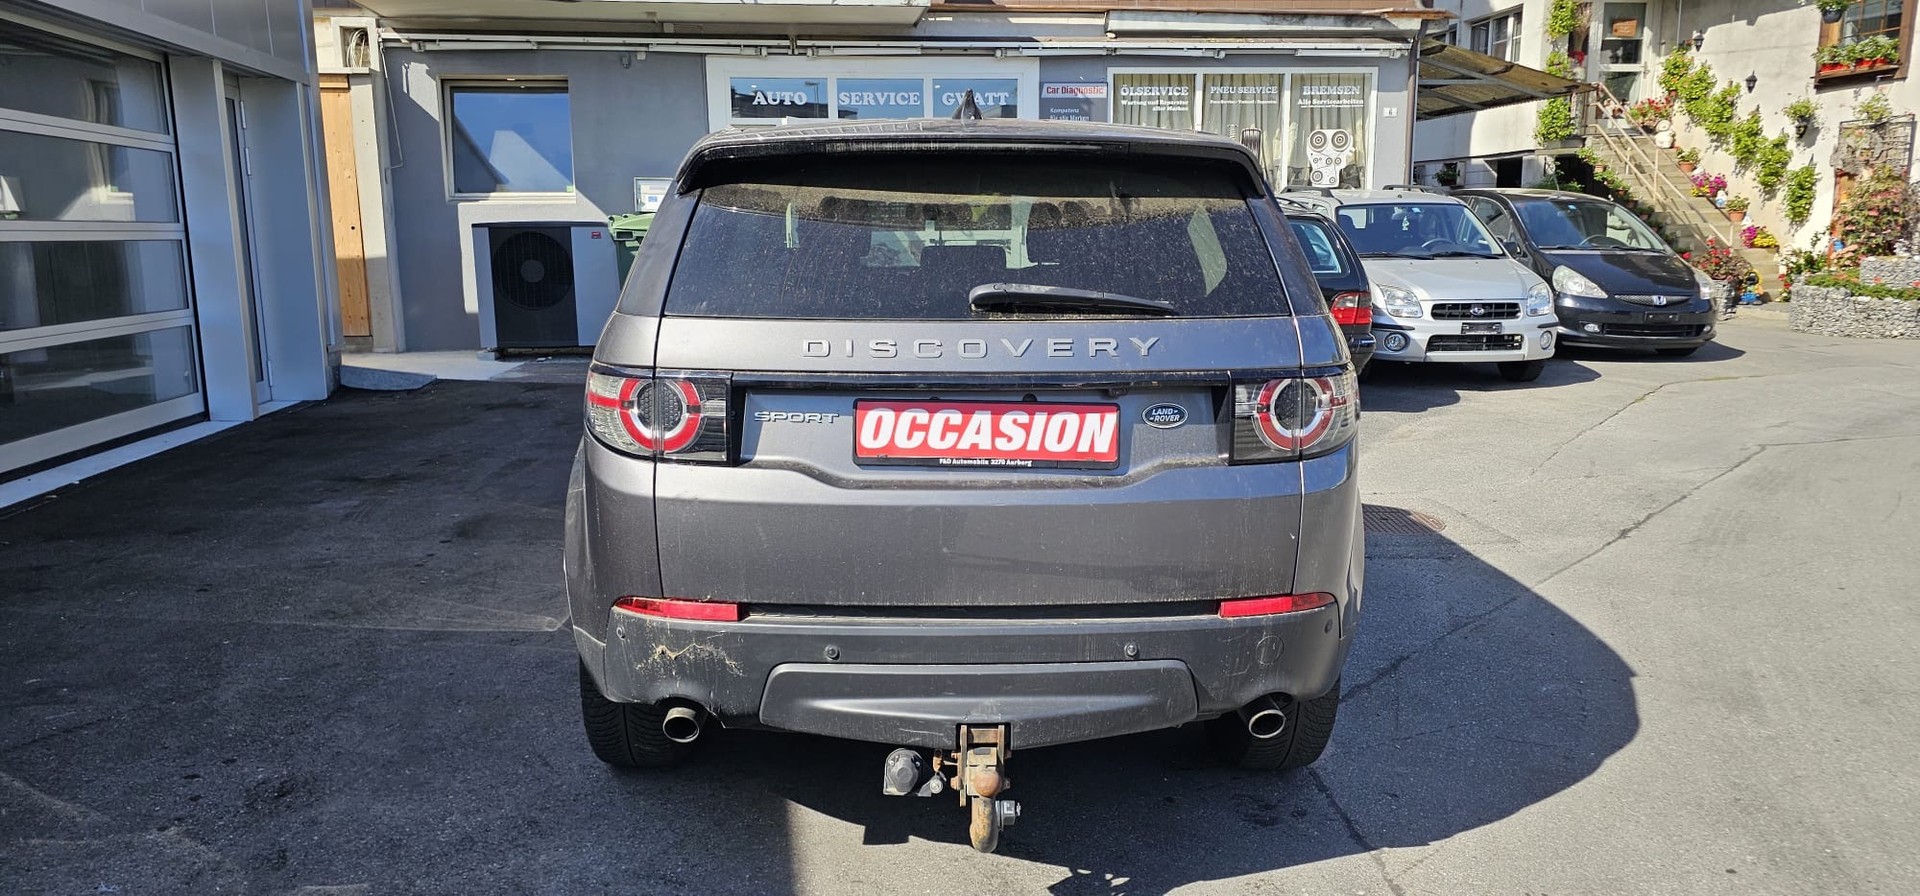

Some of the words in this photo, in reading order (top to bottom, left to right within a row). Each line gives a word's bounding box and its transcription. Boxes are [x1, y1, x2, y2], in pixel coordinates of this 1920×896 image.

[1046, 86, 1060, 94] Car
[1061, 85, 1104, 96] Diagnostic
[1120, 84, 1188, 95] ÖLSERVICE
[1210, 86, 1236, 94] PNEU
[1237, 86, 1278, 94] SERVICE
[1302, 85, 1360, 95] BREMSEN
[752, 91, 807, 106] AUTO
[838, 92, 920, 106] SERVICE
[801, 336, 1160, 359] DISCOVERY
[753, 410, 840, 425] SPORT
[1153, 414, 1180, 423] ROVER
[858, 407, 1118, 453] OCCASION
[1006, 459, 1033, 467] Aarberg
